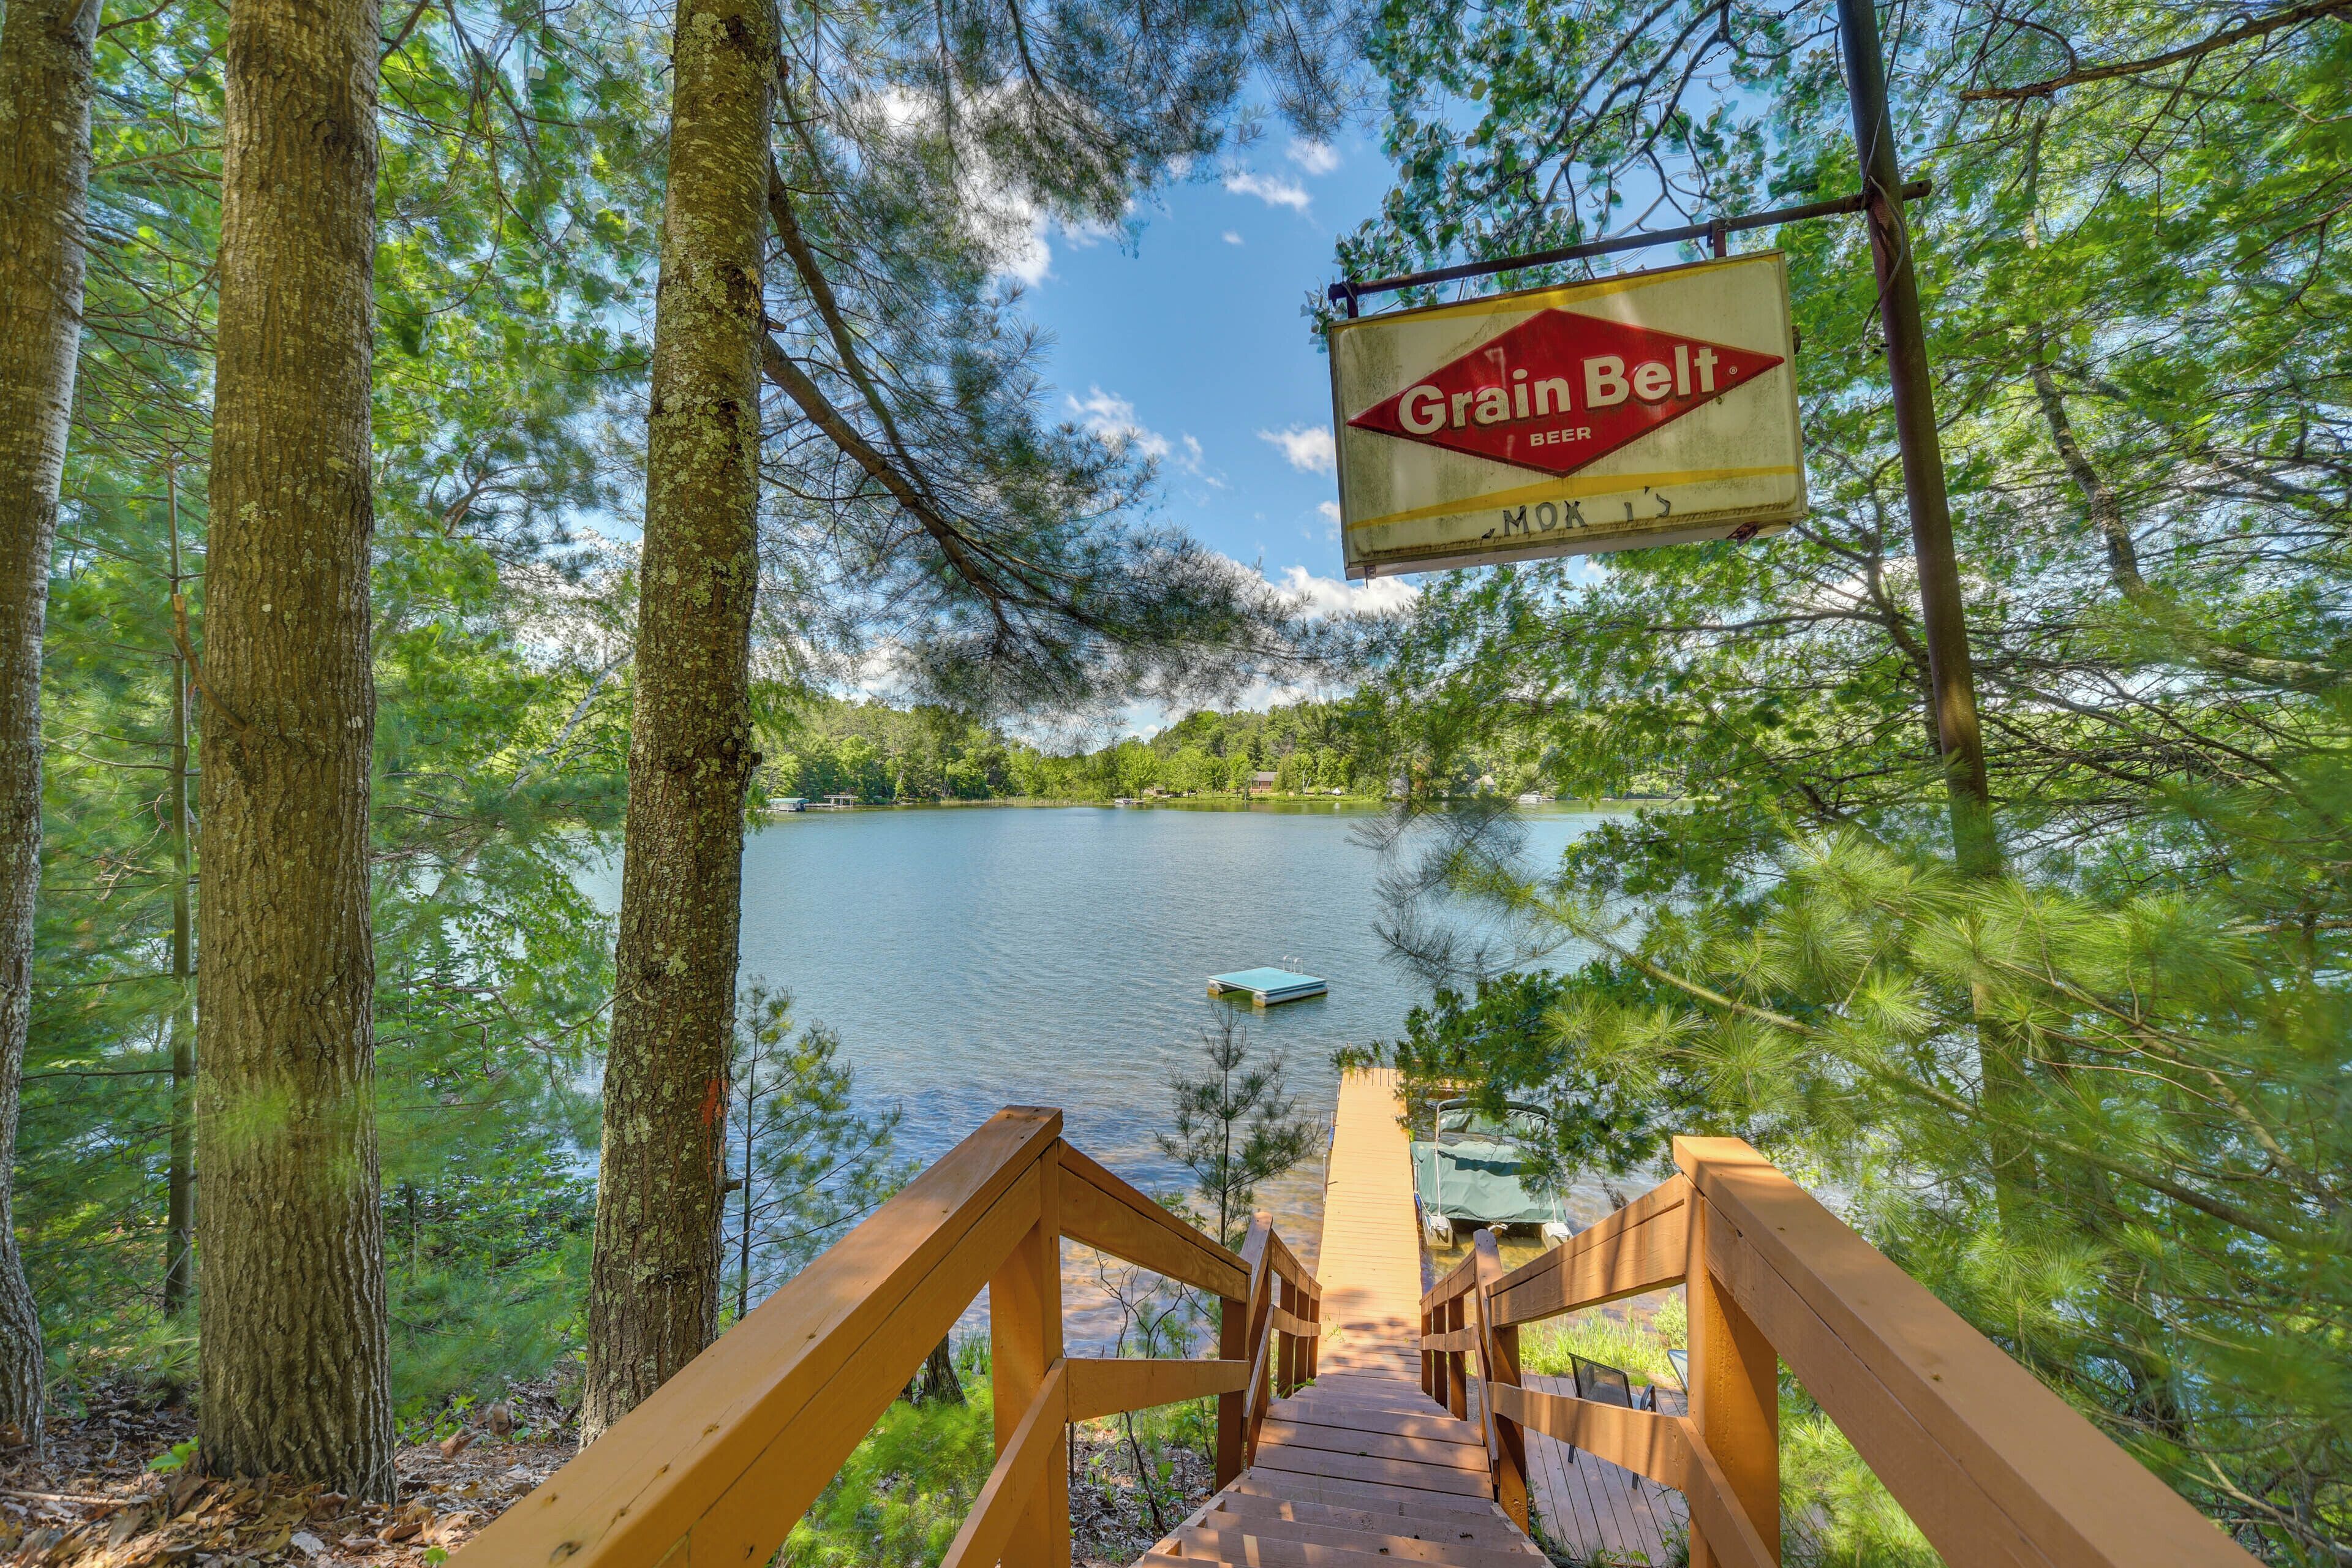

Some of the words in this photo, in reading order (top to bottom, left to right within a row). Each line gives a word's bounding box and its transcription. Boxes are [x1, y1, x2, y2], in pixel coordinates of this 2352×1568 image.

[1398, 368, 1571, 435] Grain
[1583, 345, 1718, 409] Belt
[1530, 426, 1591, 447] BEER
